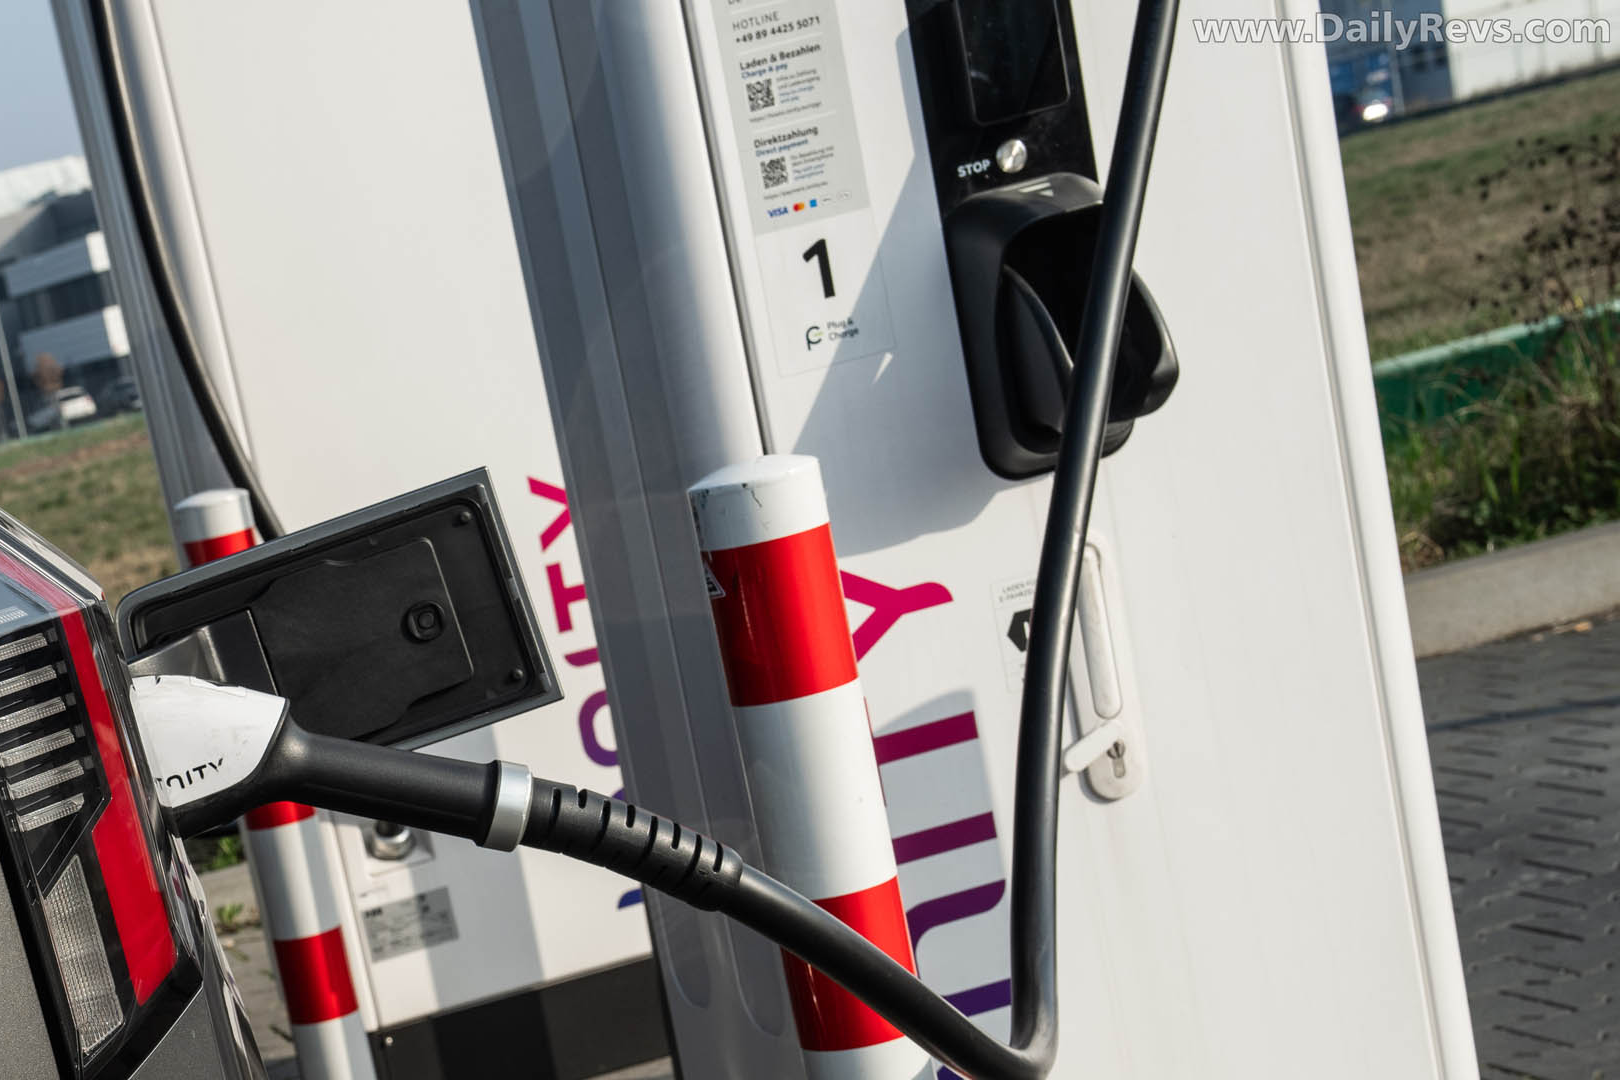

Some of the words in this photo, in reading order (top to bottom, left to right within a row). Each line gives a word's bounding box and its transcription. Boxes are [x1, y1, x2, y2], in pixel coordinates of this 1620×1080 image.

[732, 10, 781, 31] HOTLINE
[770, 21, 795, 35] 4425
[796, 15, 821, 30] 5071
[739, 57, 768, 71] Laden
[779, 43, 821, 61] Bezahlen
[753, 126, 819, 149] Direktzahlung
[956, 158, 991, 178] STOP
[767, 205, 789, 218] VISA
[802, 238, 836, 299] 1
